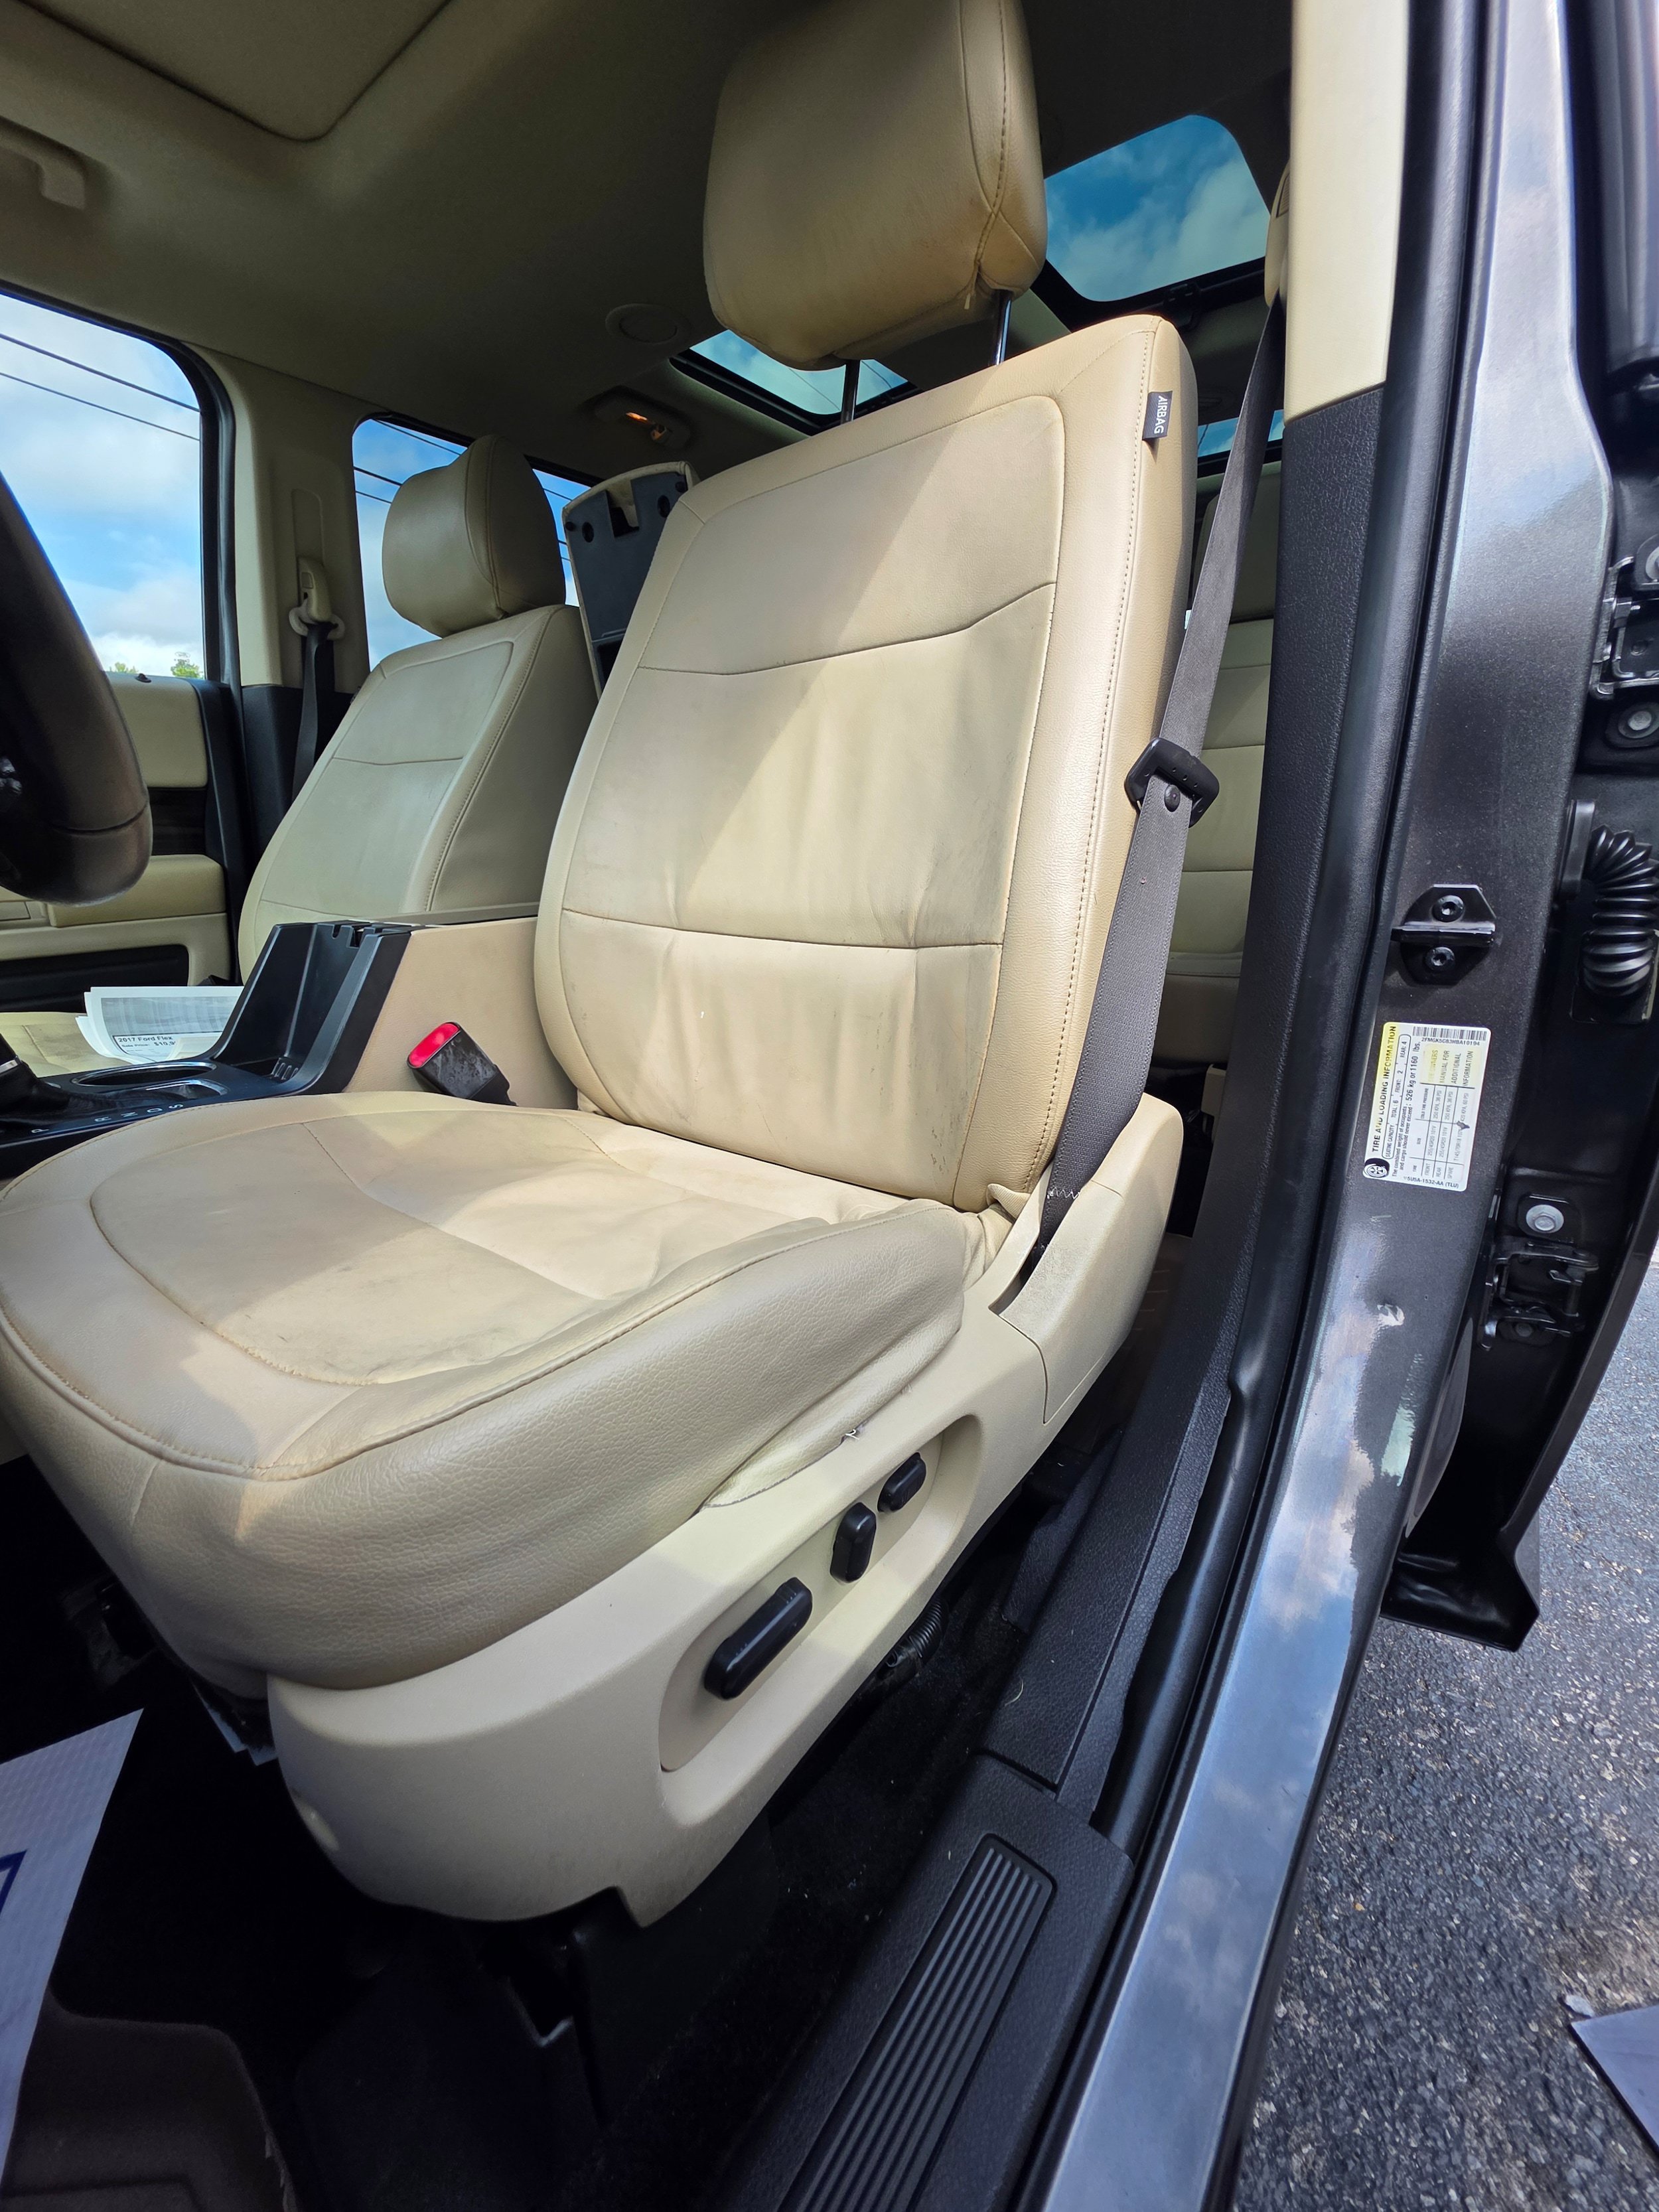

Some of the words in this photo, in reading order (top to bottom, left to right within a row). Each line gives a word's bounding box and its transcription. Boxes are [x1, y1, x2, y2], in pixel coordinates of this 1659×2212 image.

[1154, 396, 1168, 433] AIRBAG
[1378, 1082, 1388, 1115] LOADING
[1383, 1026, 1396, 1079] INFORMATION
[1409, 1056, 1418, 1070] 1160
[1439, 1062, 1448, 1083] MANUAL
[1451, 1053, 1461, 1084] ADDITIONAL
[1463, 1051, 1474, 1086] INFORMATION
